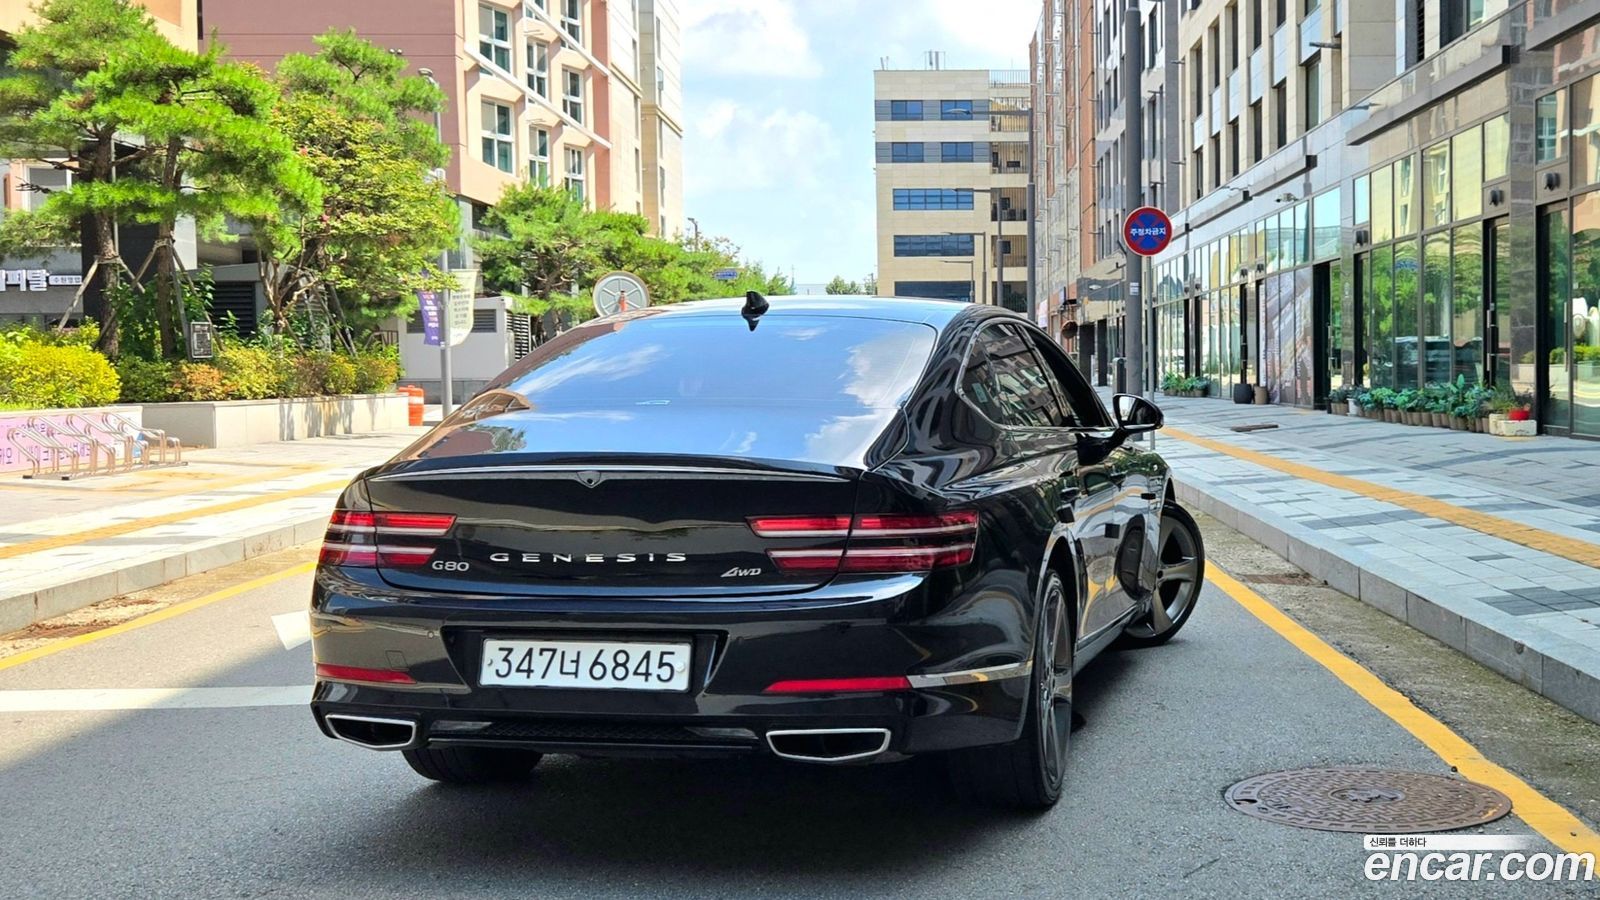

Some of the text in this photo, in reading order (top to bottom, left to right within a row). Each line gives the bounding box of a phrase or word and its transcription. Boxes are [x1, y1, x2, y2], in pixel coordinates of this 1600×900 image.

[1130, 227, 1166, 237] 주정차금지
[0, 269, 47, 291] 피탈
[490, 552, 688, 564] GENESIS
[432, 560, 470, 572] G80
[721, 566, 762, 578] AWD
